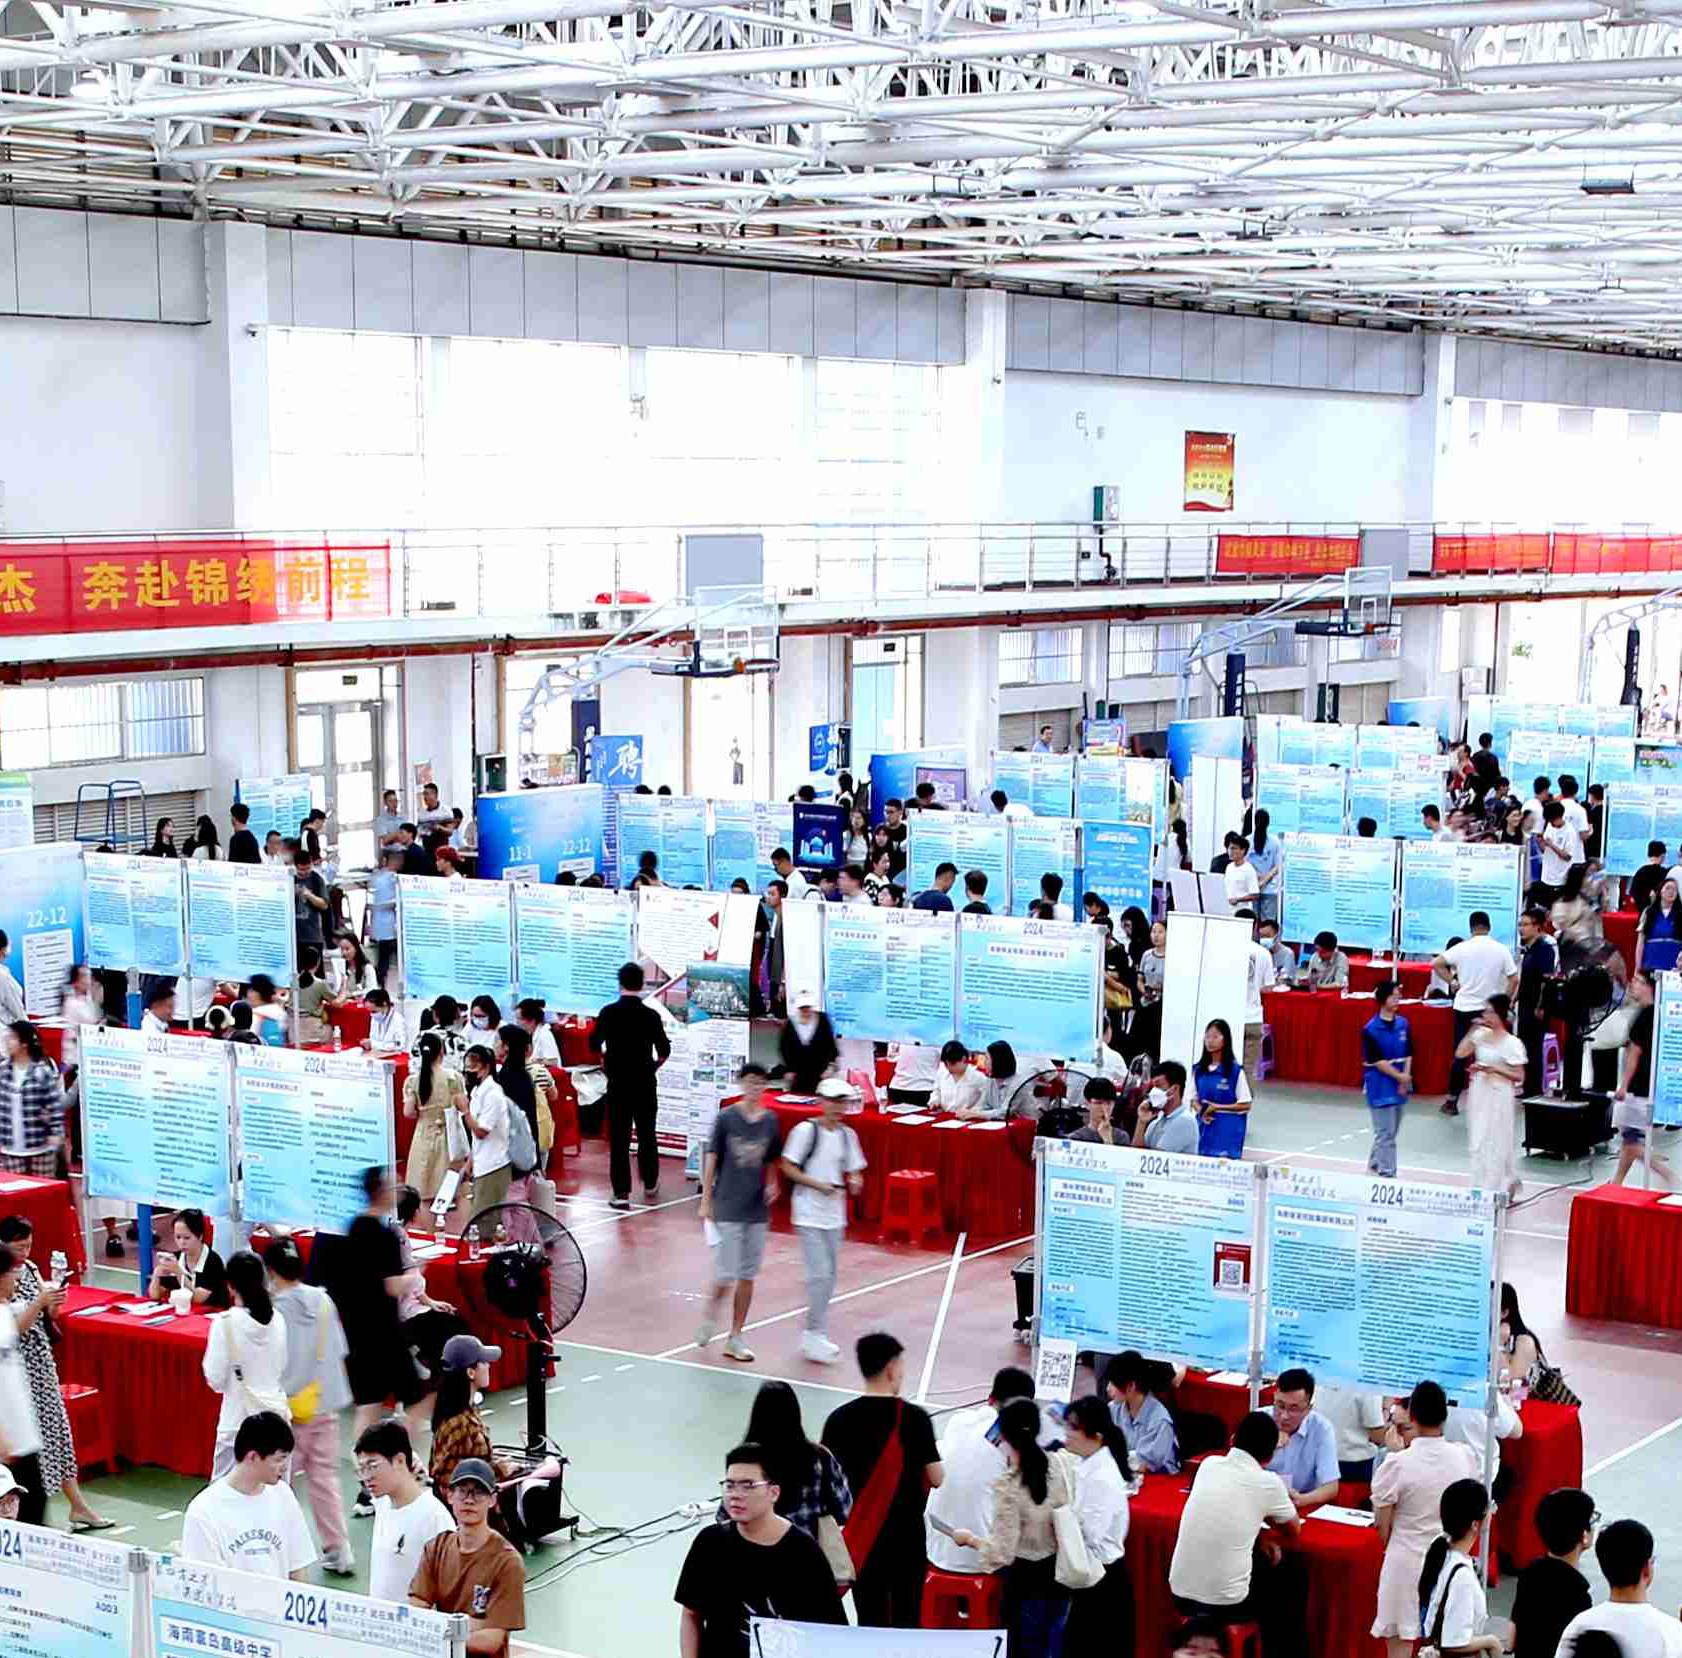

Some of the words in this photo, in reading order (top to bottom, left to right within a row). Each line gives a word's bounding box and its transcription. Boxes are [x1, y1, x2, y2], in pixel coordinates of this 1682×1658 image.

[84, 557, 373, 609] 奔赴锦绣前程
[1139, 1155, 1170, 1177] 2024
[1372, 1184, 1404, 1207] 2024
[283, 1591, 330, 1631] 2024
